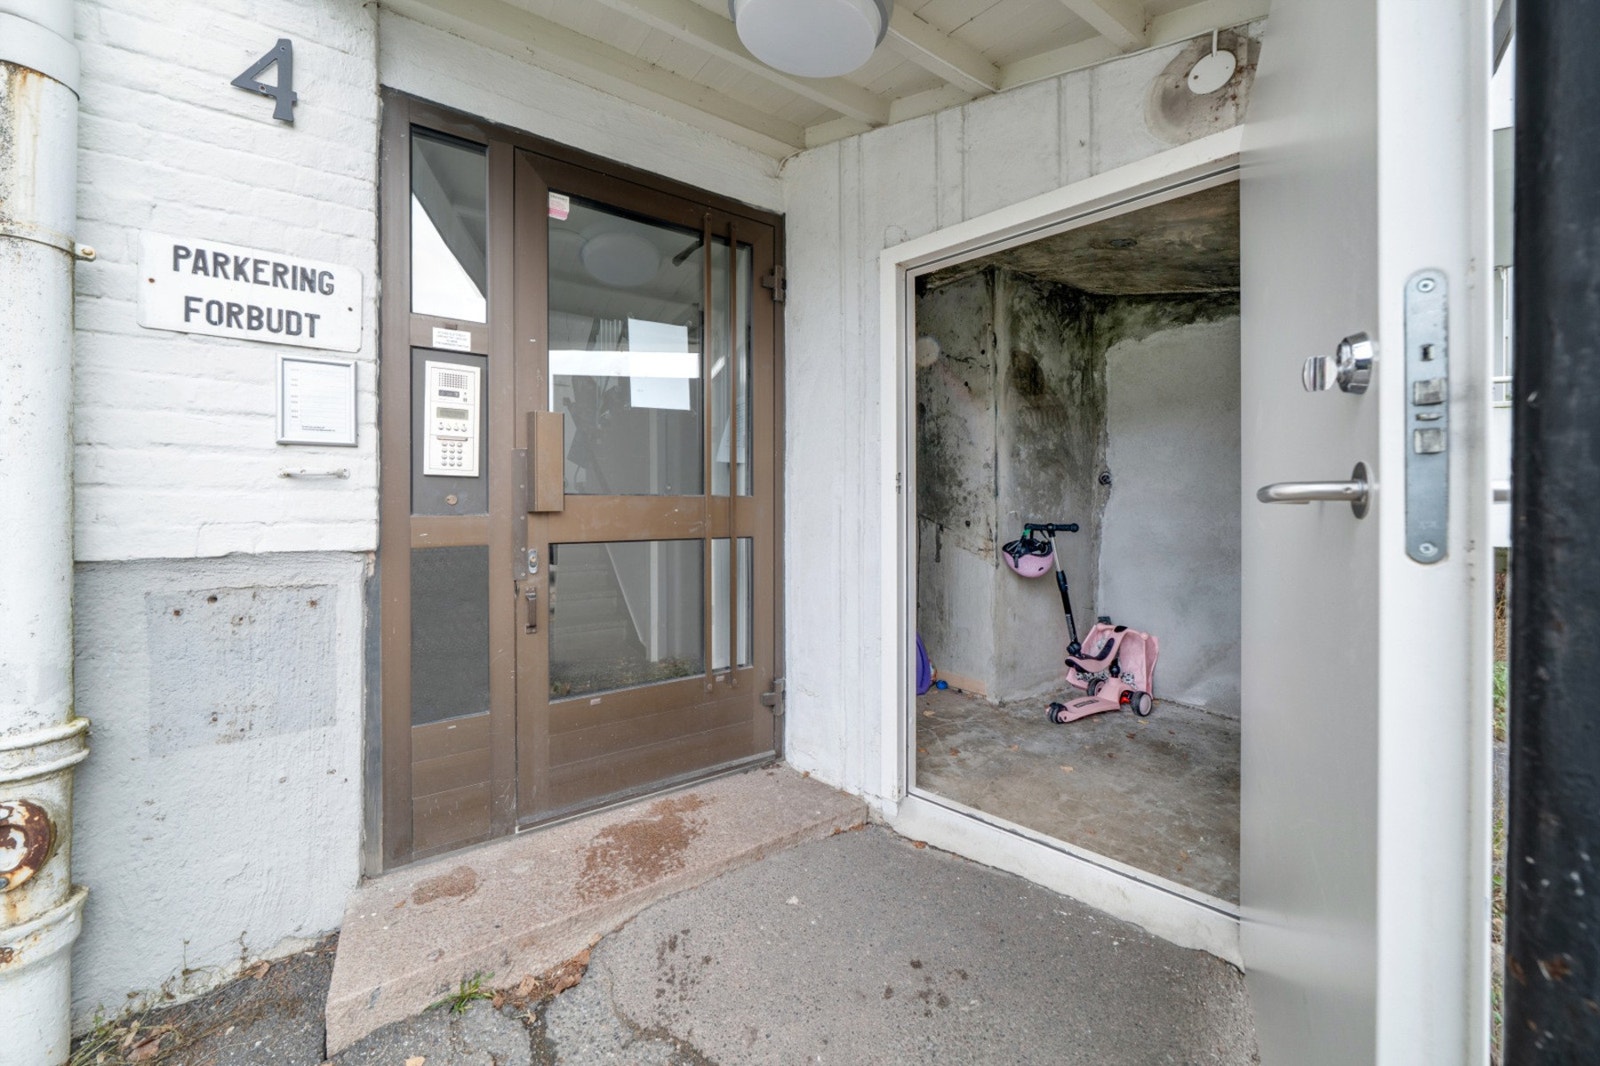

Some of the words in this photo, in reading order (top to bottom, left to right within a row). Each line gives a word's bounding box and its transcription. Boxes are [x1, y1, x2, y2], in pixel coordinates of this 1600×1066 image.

[231, 39, 297, 123] 4
[173, 245, 335, 296] PARKERING
[184, 296, 321, 338] FORBUDT
